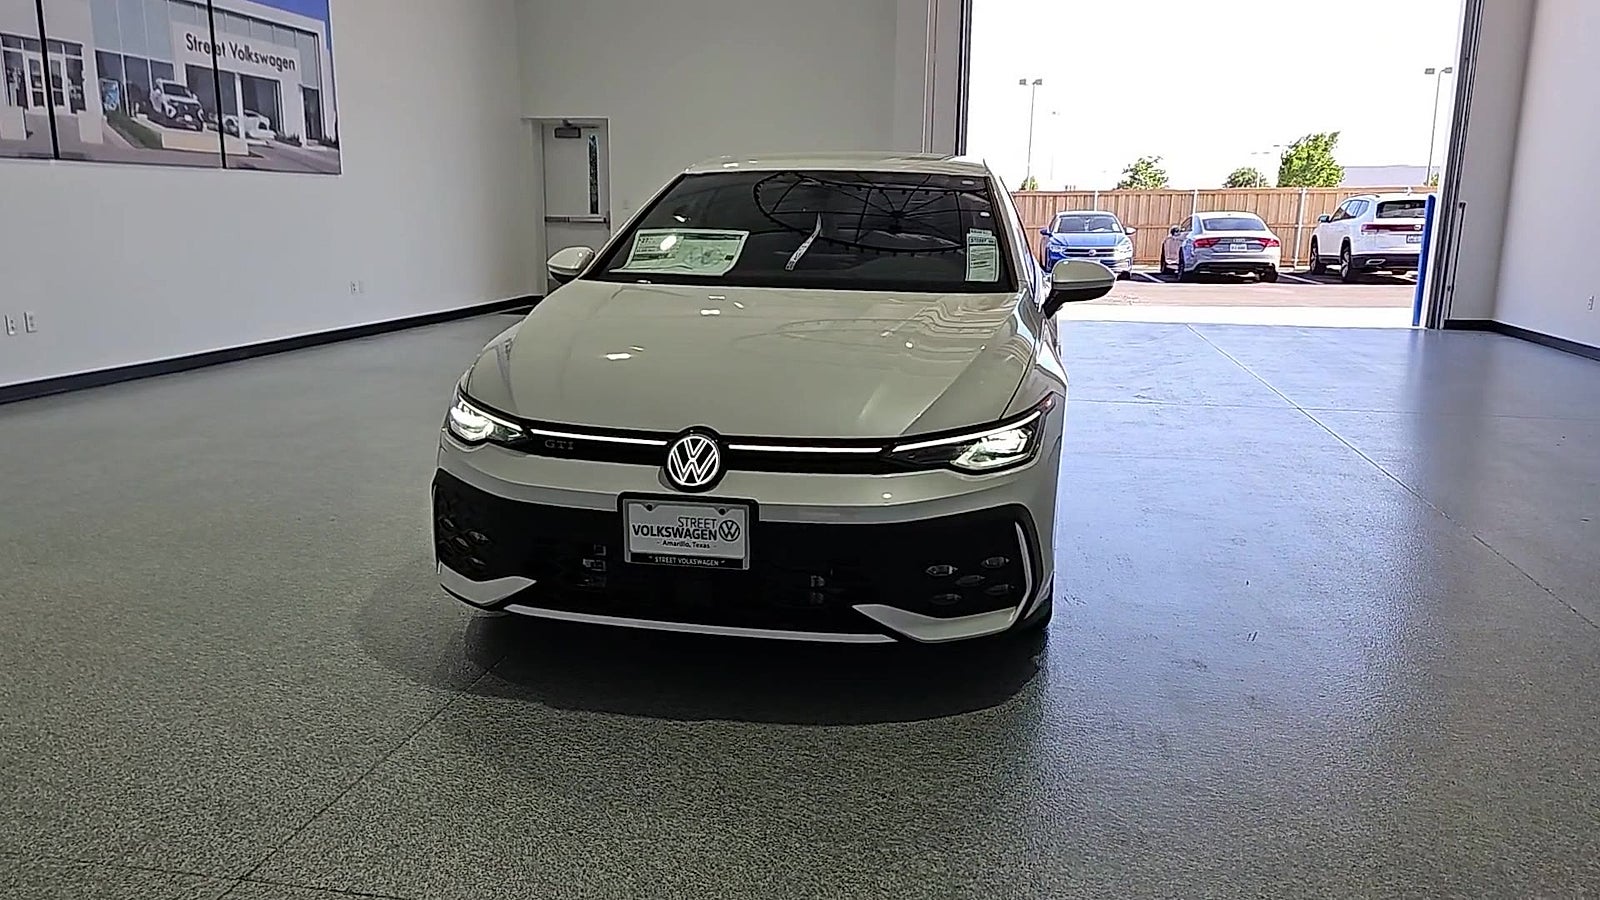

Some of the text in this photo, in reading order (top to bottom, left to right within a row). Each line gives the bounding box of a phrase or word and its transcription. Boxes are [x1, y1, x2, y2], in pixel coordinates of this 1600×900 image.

[186, 33, 296, 72] Street Volkswagen
[544, 439, 574, 450] GTI
[678, 516, 717, 529] STREET
[632, 524, 717, 541] VOLKSWAGEN
[692, 541, 710, 549] Texas
[655, 556, 719, 567] STREET VOLKSWAGEN
